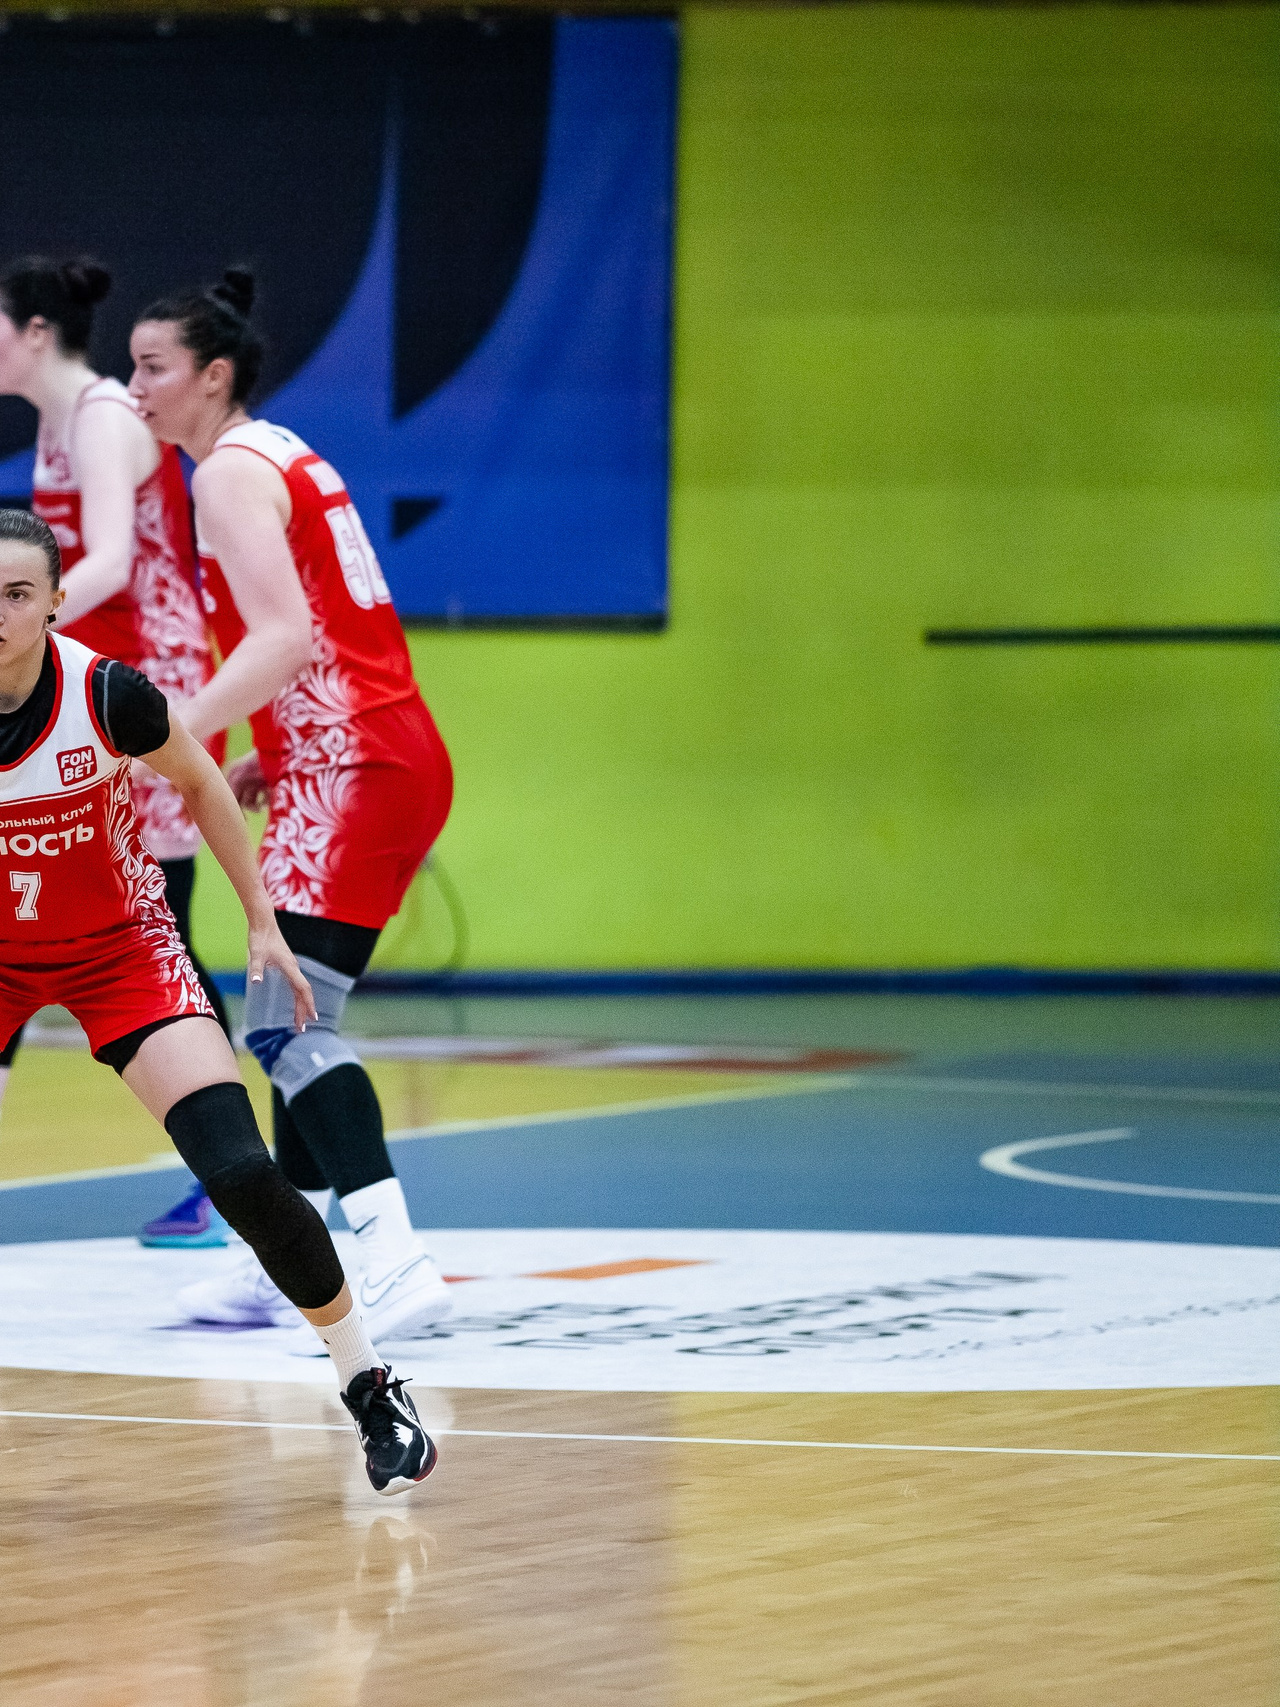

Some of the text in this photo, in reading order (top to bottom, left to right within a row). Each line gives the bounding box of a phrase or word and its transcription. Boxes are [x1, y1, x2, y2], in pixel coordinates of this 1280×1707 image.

[60, 750, 93, 769] FON
[63, 763, 94, 782] BET
[61, 802, 93, 821] КЛУБ
[9, 871, 41, 921] 7
